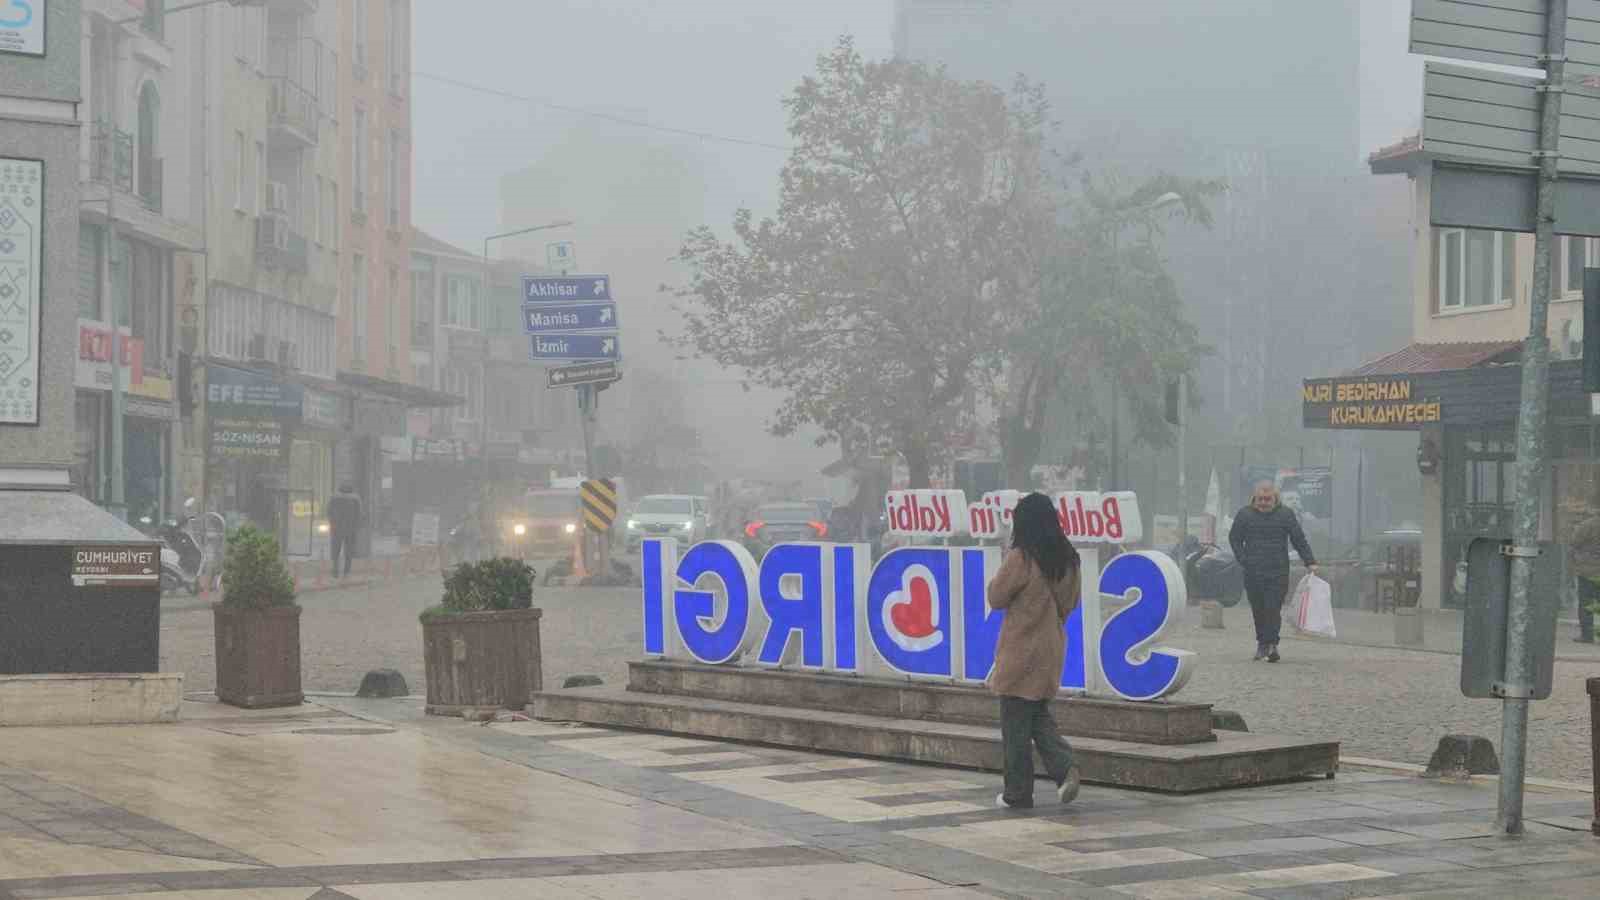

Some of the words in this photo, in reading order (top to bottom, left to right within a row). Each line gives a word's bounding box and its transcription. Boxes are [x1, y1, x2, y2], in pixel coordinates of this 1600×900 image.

[528, 282, 578, 297] Akhisar
[529, 313, 579, 328] Manisa
[536, 336, 569, 353] İzmir
[208, 383, 244, 403] EFE
[1337, 378, 1411, 402] BEDİRHAN
[76, 550, 152, 563] CUMHURİYET
